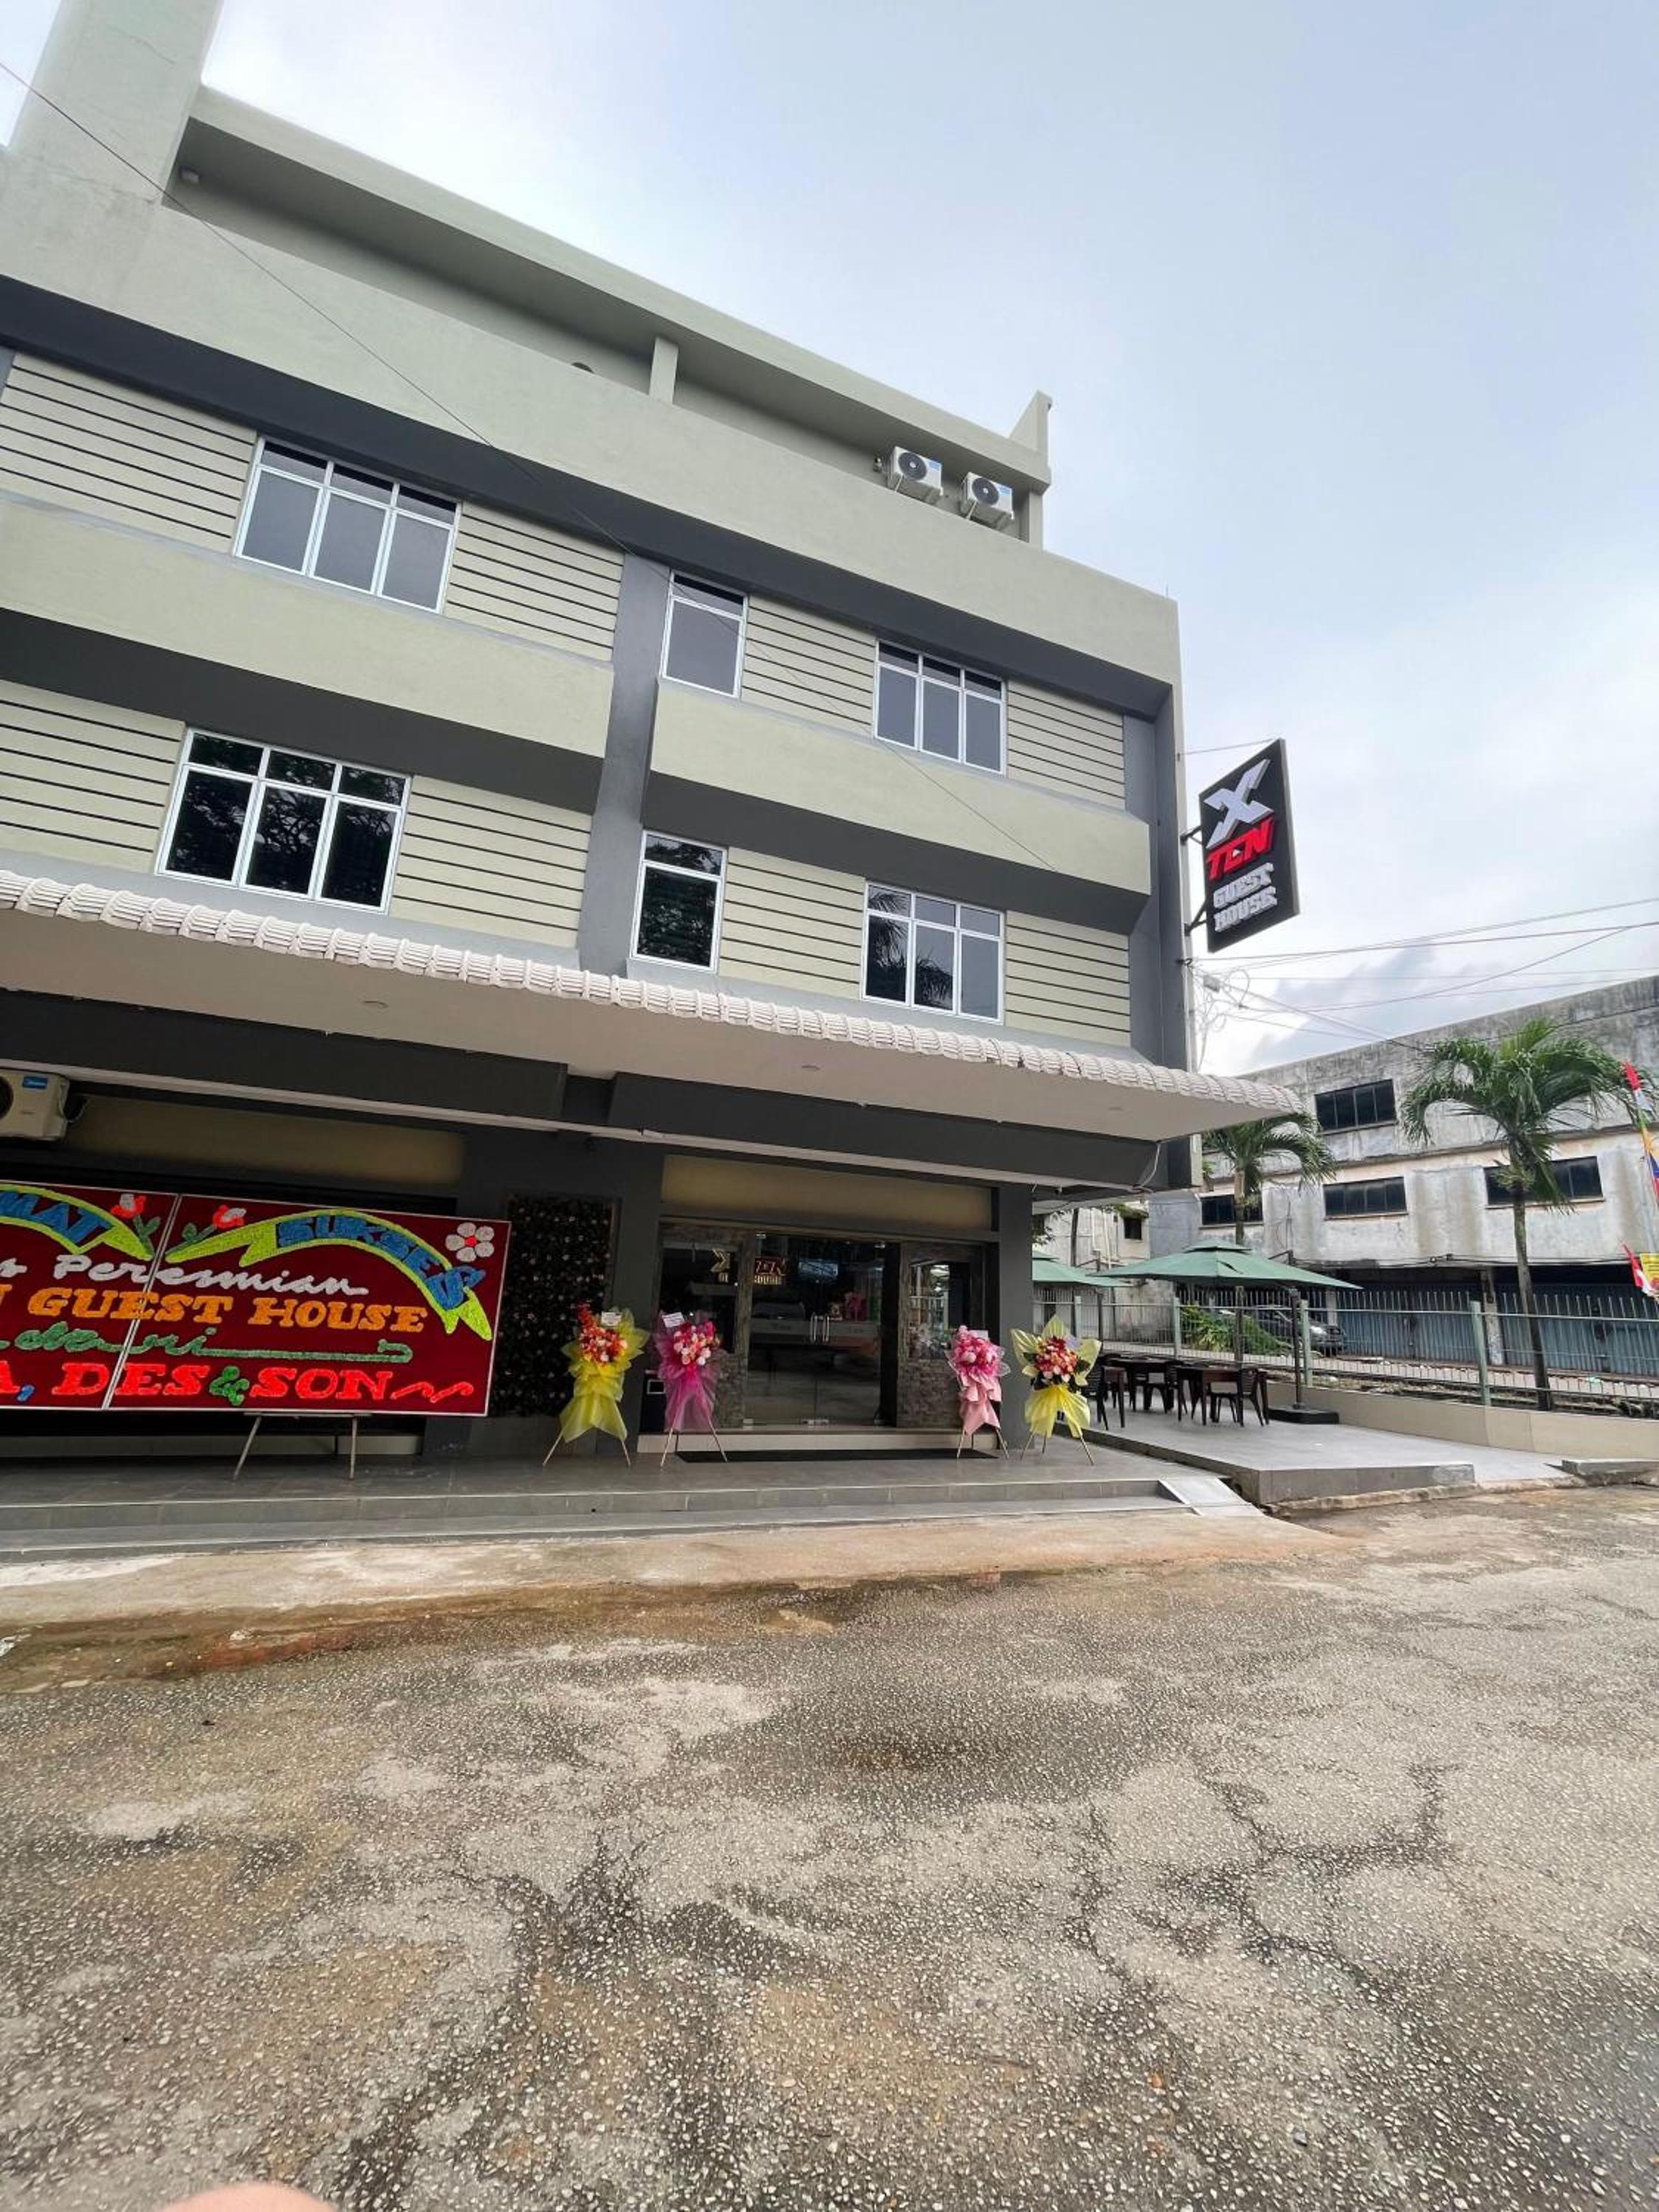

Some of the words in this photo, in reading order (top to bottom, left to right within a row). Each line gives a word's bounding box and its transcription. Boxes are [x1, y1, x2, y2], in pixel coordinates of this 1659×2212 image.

[1203, 759, 1274, 849] X
[1214, 863, 1275, 909] GUEST
[1214, 886, 1278, 933] HOUSE
[28, 1287, 234, 1324] GUEST
[248, 1297, 427, 1332] HOUSE
